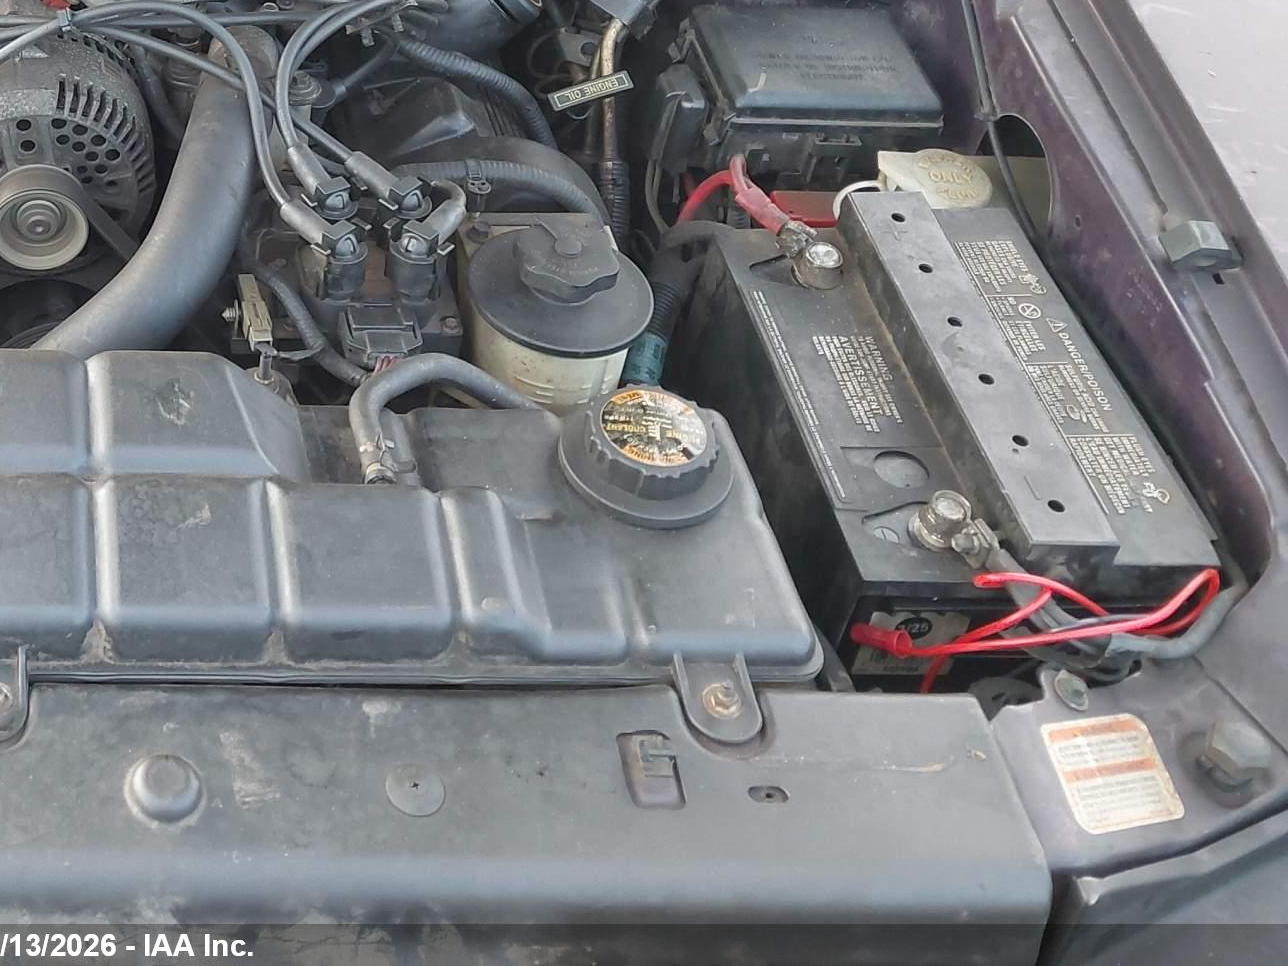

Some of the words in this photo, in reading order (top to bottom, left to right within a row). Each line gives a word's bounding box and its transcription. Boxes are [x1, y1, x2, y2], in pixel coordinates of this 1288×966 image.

[565, 91, 582, 101] OIL
[929, 169, 974, 185] ONLY
[838, 336, 883, 414] AVERTISSEMENT
[865, 336, 893, 381] WARNING
[1058, 332, 1112, 411] DANGER/POISON
